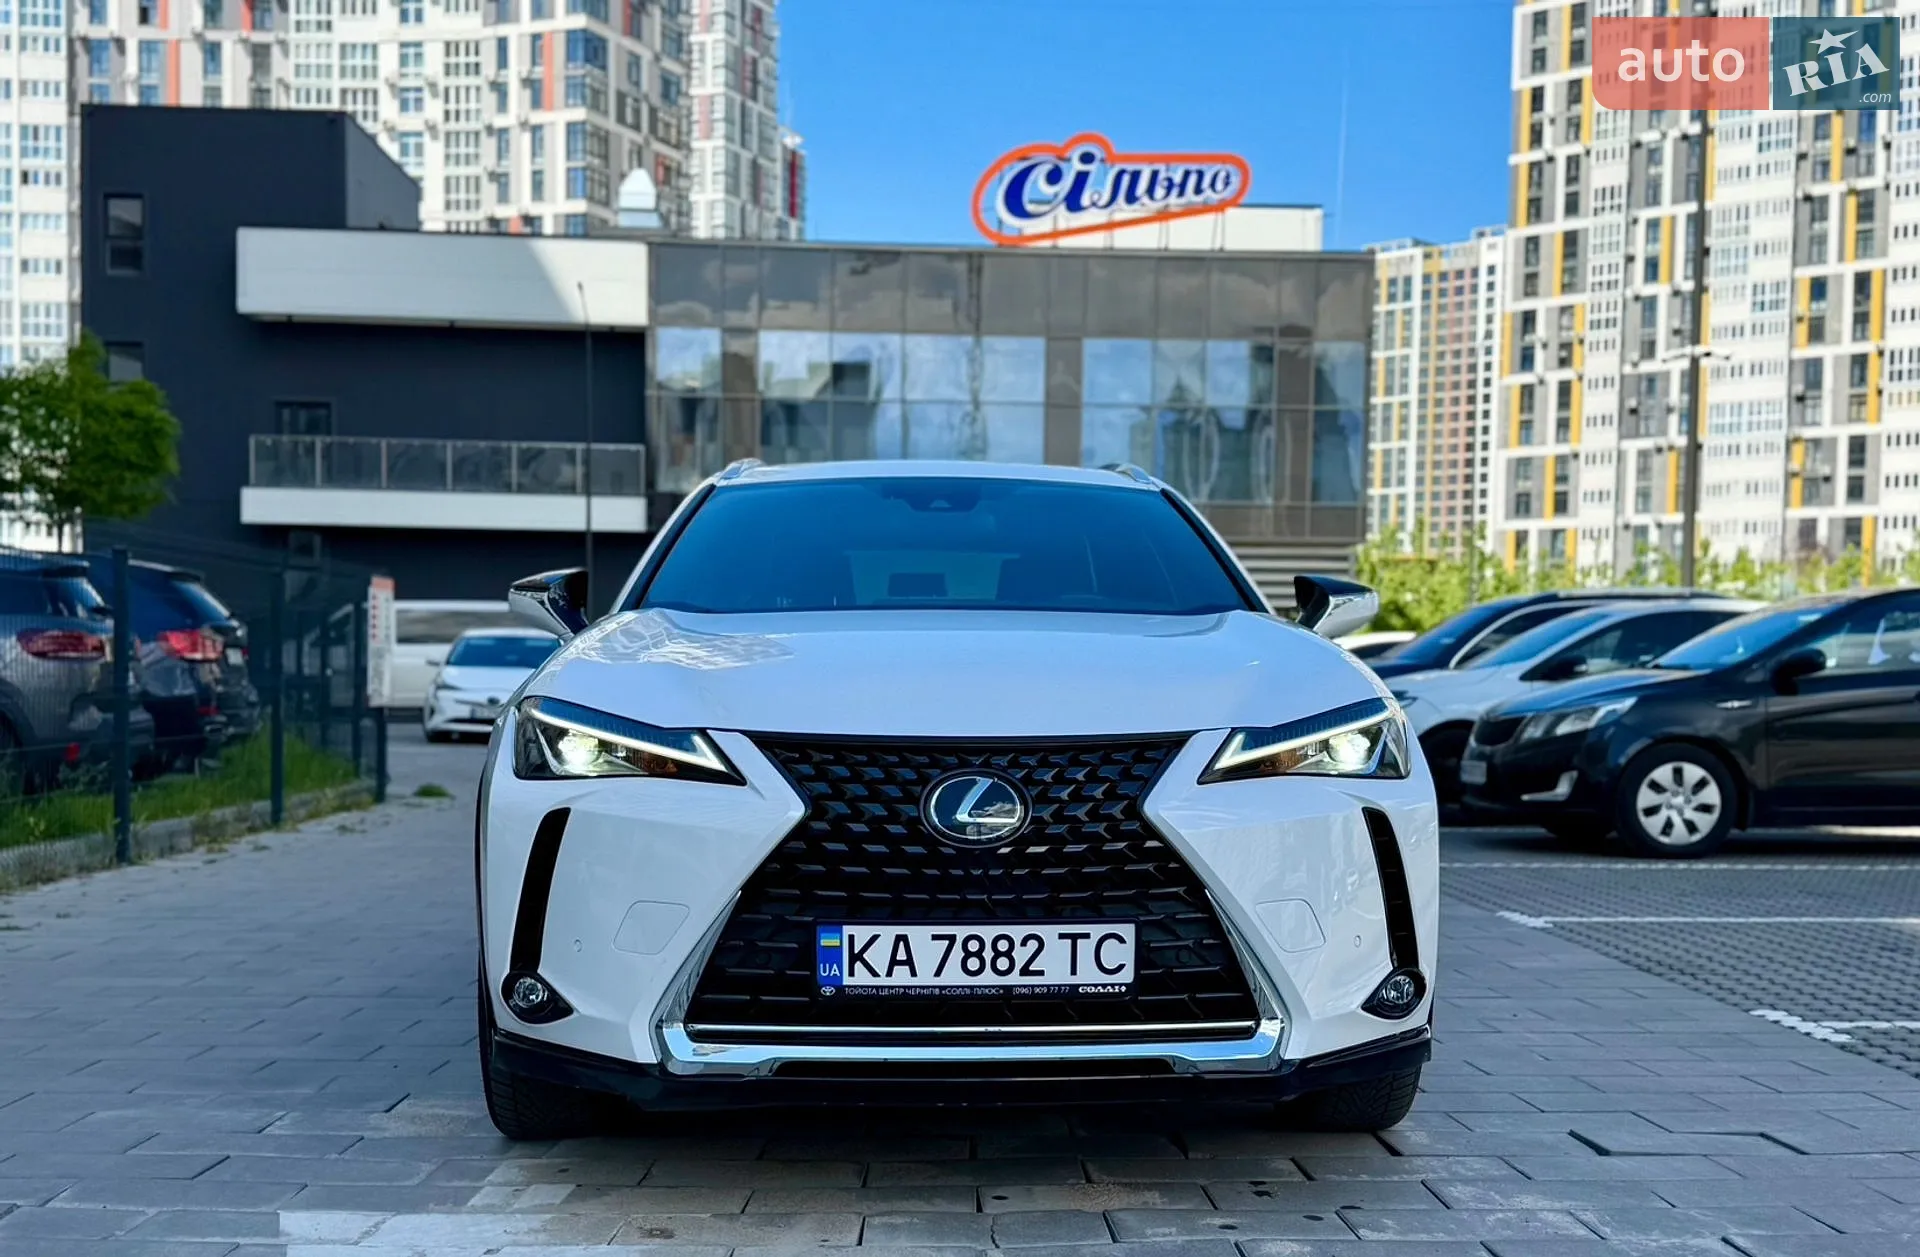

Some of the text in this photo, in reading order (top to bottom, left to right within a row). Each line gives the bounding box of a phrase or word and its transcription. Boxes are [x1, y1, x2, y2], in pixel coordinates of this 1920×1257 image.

[1004, 151, 1230, 219] Сільпо
[820, 963, 841, 977] UA
[847, 932, 1127, 978] KA 7882 TC
